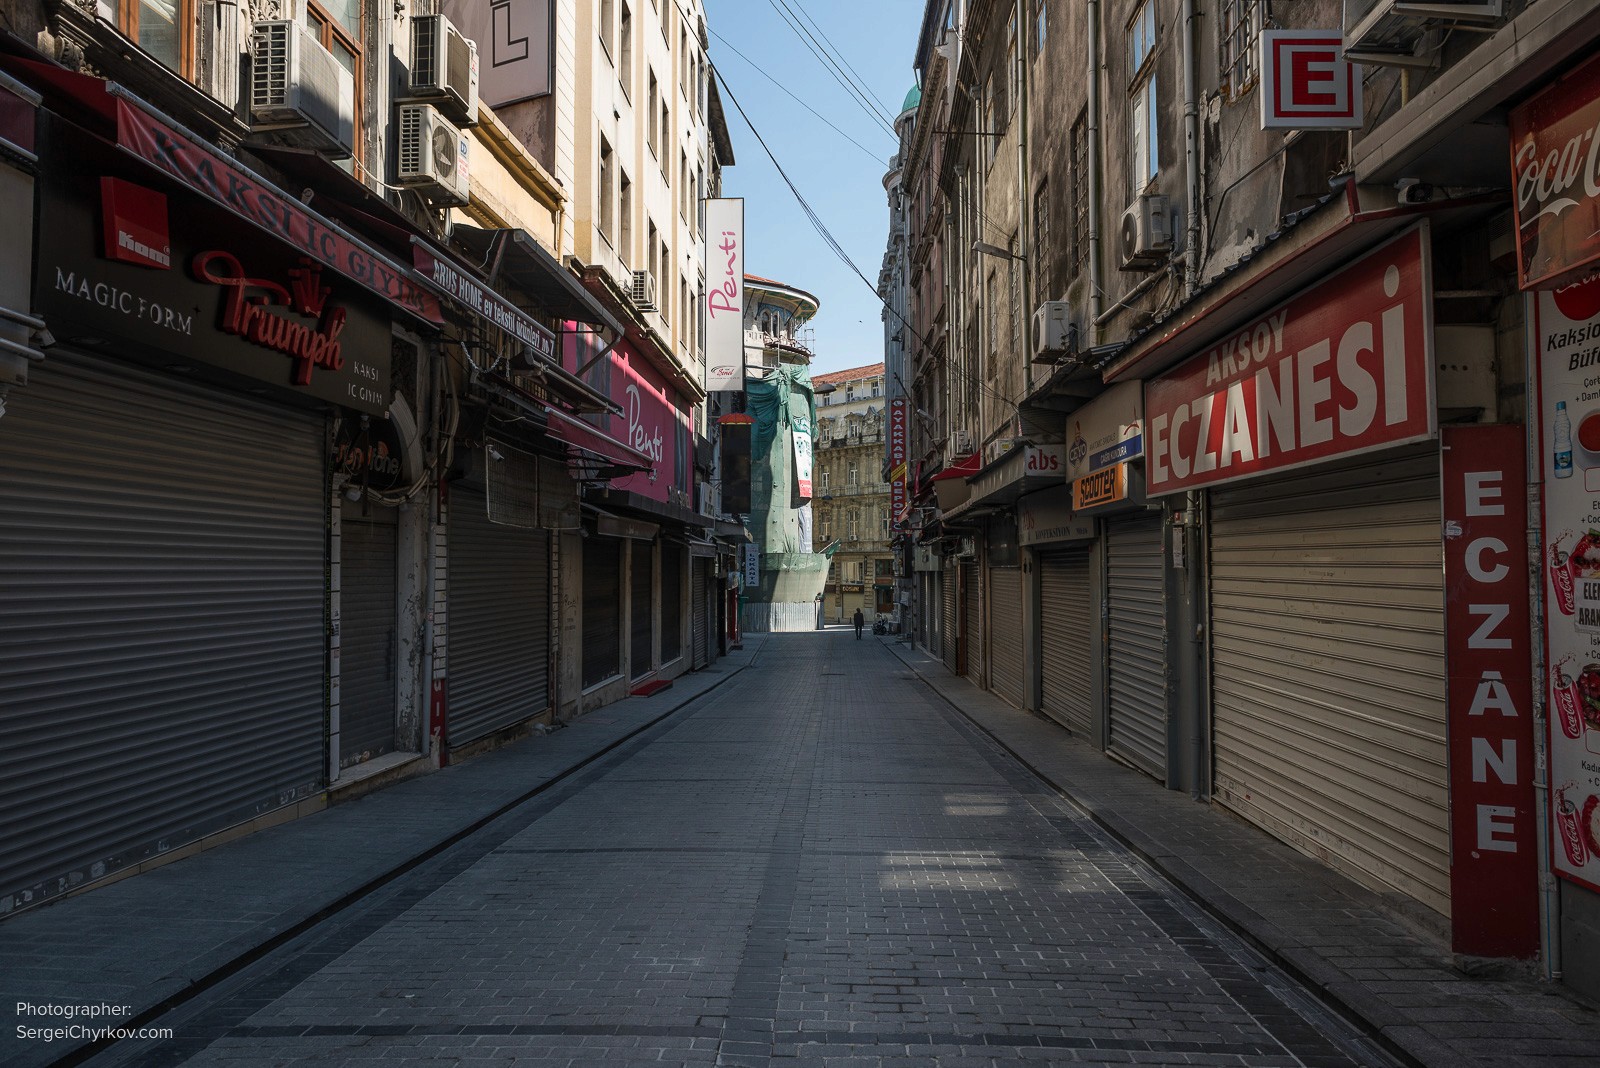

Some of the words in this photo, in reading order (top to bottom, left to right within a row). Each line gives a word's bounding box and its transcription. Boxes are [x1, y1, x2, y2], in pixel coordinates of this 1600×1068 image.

[1292, 52, 1336, 105] E
[55, 266, 132, 314] MAGIC
[137, 297, 192, 336] FORM
[433, 258, 457, 294] ARUS
[458, 276, 482, 311] HOME
[483, 298, 493, 318] ev
[494, 302, 515, 333] tekstil
[708, 231, 740, 318] Penti
[191, 249, 347, 385] Triumph
[1206, 308, 1287, 388] AKSOY
[1568, 347, 1600, 371] Büf
[626, 384, 663, 463] Penti
[1581, 389, 1600, 402] Dam
[893, 409, 903, 465] AYAKKABI
[1027, 448, 1058, 471] abs
[1080, 467, 1116, 507] SCOOTER
[748, 553, 756, 585] LOKANTA
[1463, 470, 1519, 854] ECZANE
